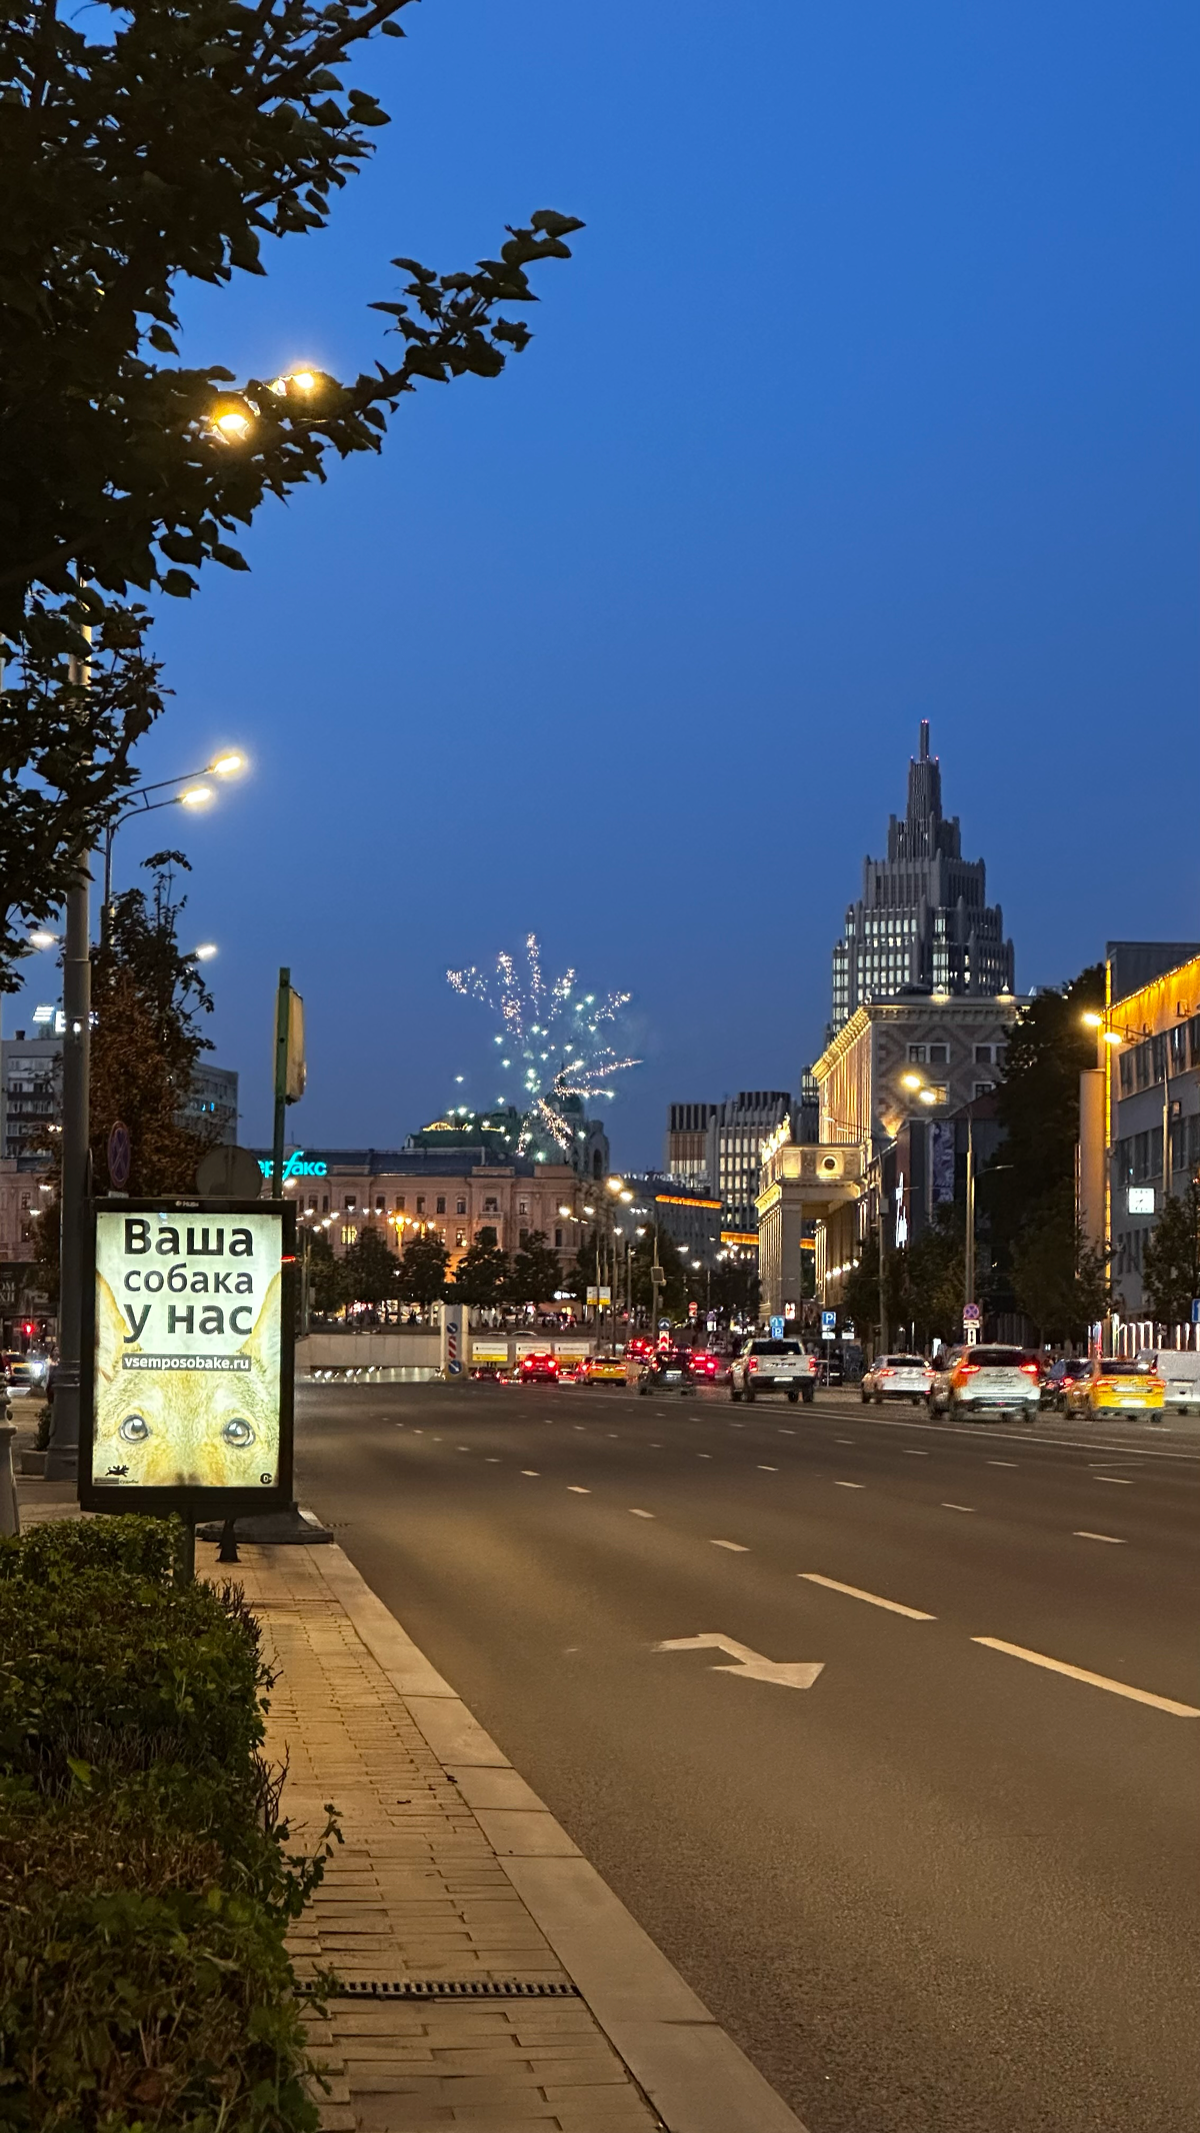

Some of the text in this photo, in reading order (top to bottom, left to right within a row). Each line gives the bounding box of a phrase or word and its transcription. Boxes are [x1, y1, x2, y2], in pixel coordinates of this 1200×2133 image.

[124, 1218, 254, 1257] Ваша
[123, 1262, 254, 1294] собака
[123, 1303, 253, 1344] у нас
[124, 1356, 249, 1370] vsemposobake.ru
